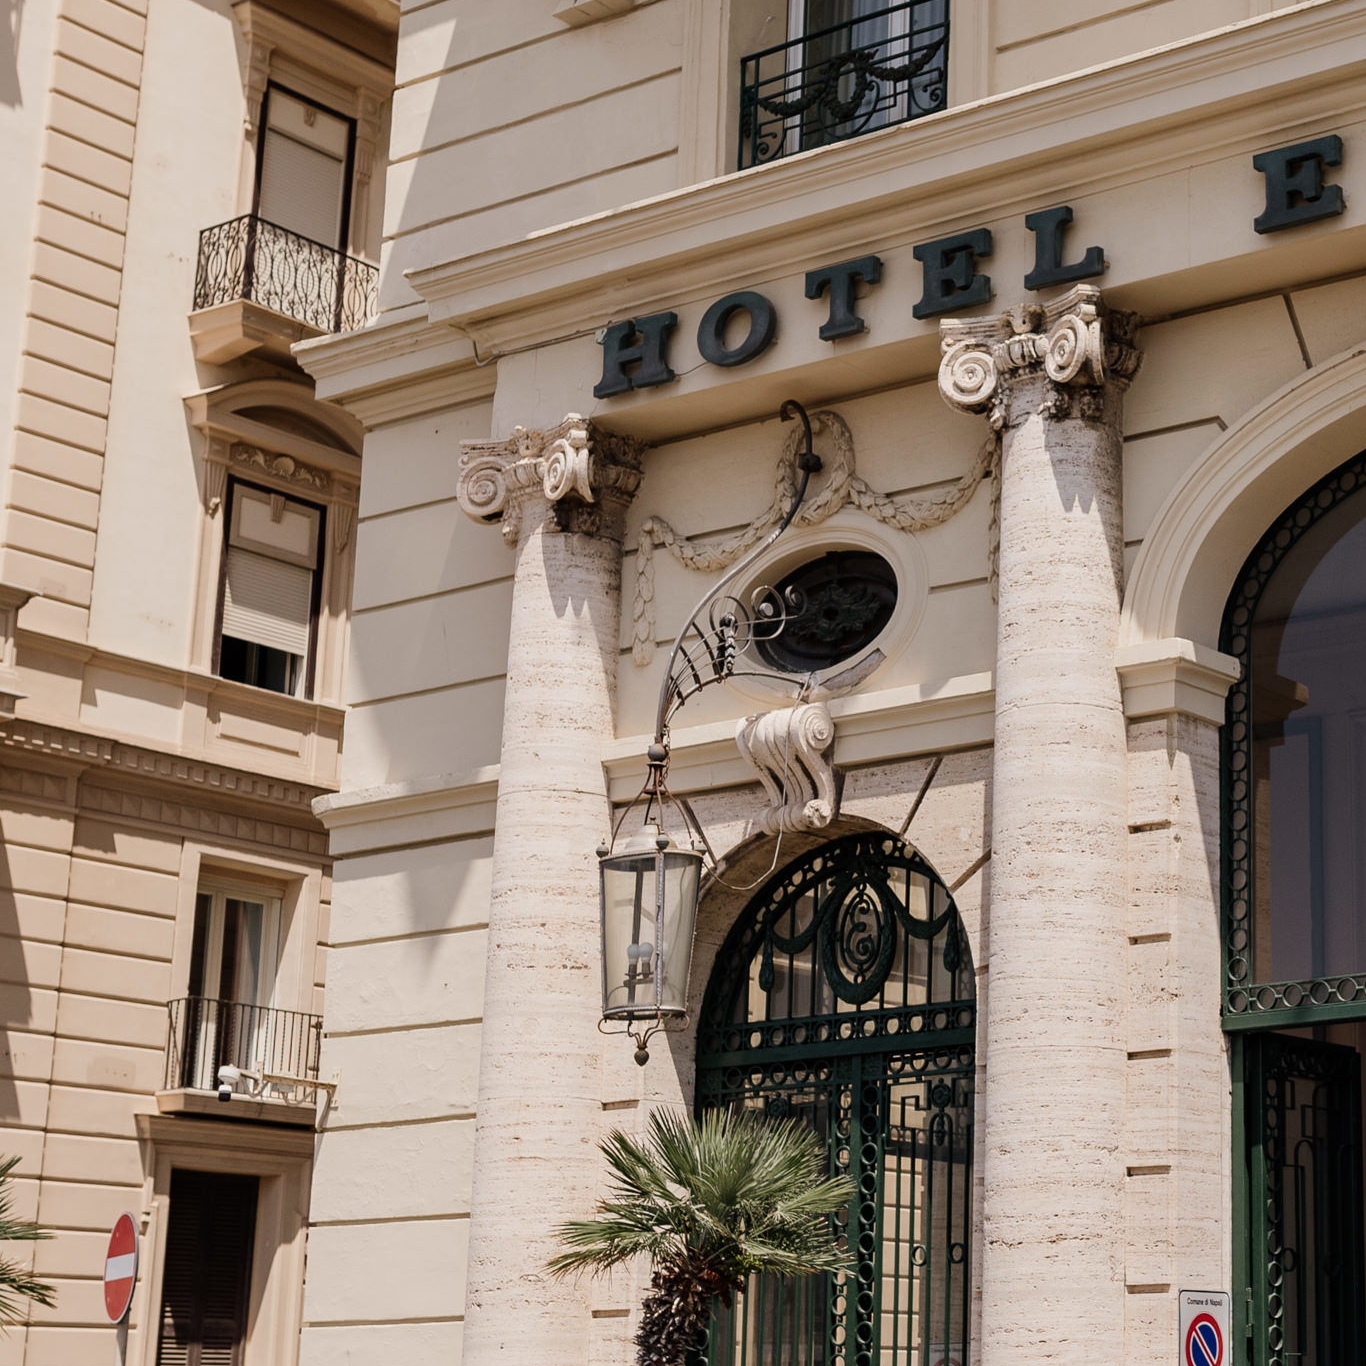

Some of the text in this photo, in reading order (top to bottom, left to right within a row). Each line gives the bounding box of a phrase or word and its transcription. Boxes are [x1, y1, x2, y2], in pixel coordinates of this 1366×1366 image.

[593, 206, 1106, 399] HOTEL
[1187, 1297, 1204, 1306] Comune
[1210, 1298, 1223, 1307] Napoli
